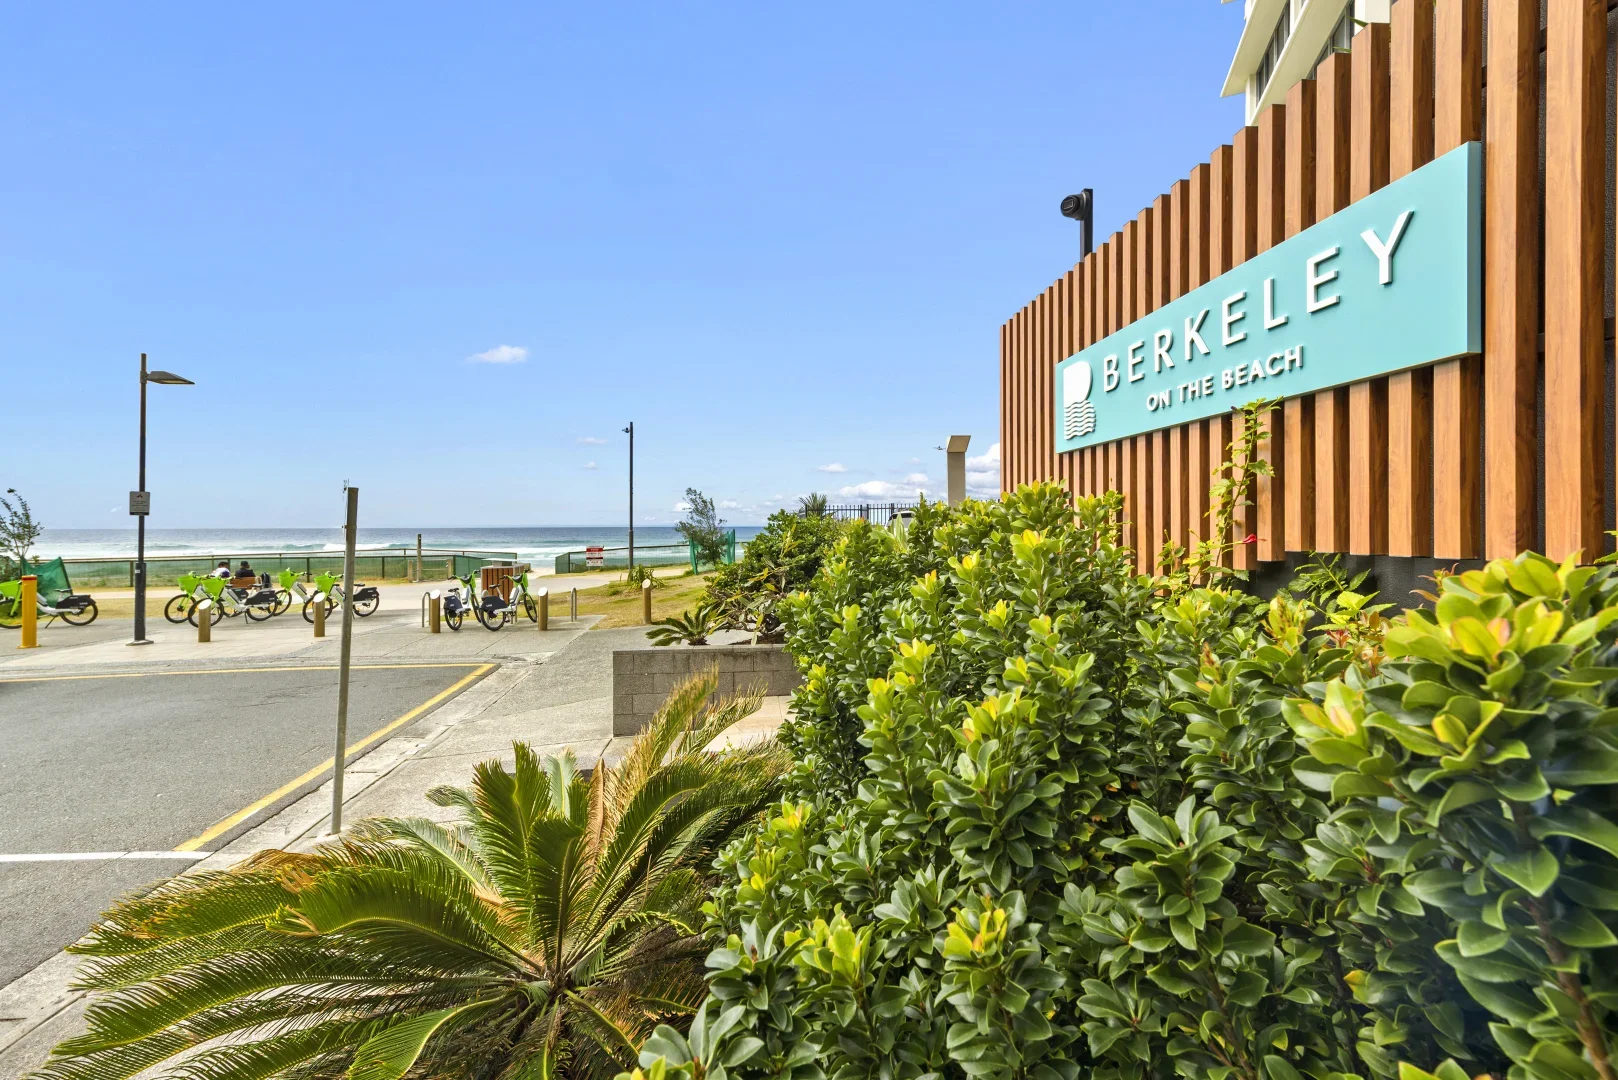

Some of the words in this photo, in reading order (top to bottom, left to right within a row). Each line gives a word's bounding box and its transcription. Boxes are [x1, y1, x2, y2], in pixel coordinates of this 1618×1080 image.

[1103, 209, 1415, 393] BERKELEY
[1146, 389, 1172, 412] ON
[1177, 376, 1215, 402] THE
[1221, 345, 1304, 389] BEACH
